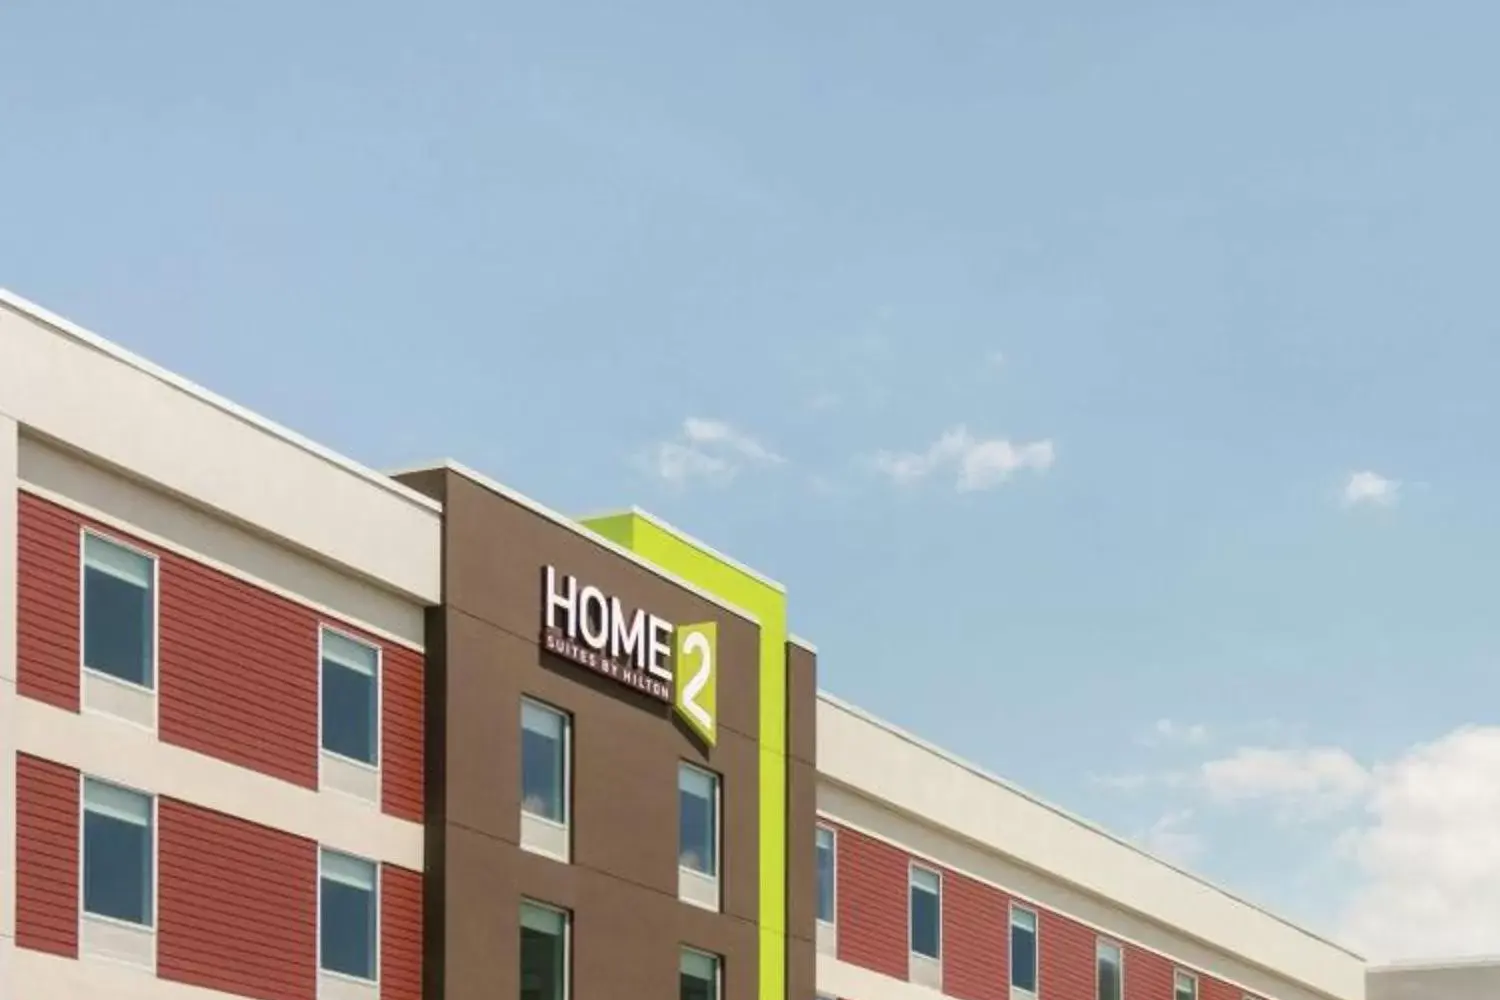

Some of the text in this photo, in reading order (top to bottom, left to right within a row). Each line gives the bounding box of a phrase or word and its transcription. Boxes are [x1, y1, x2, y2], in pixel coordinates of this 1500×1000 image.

[546, 635, 670, 700] SUITES BY HILTON
